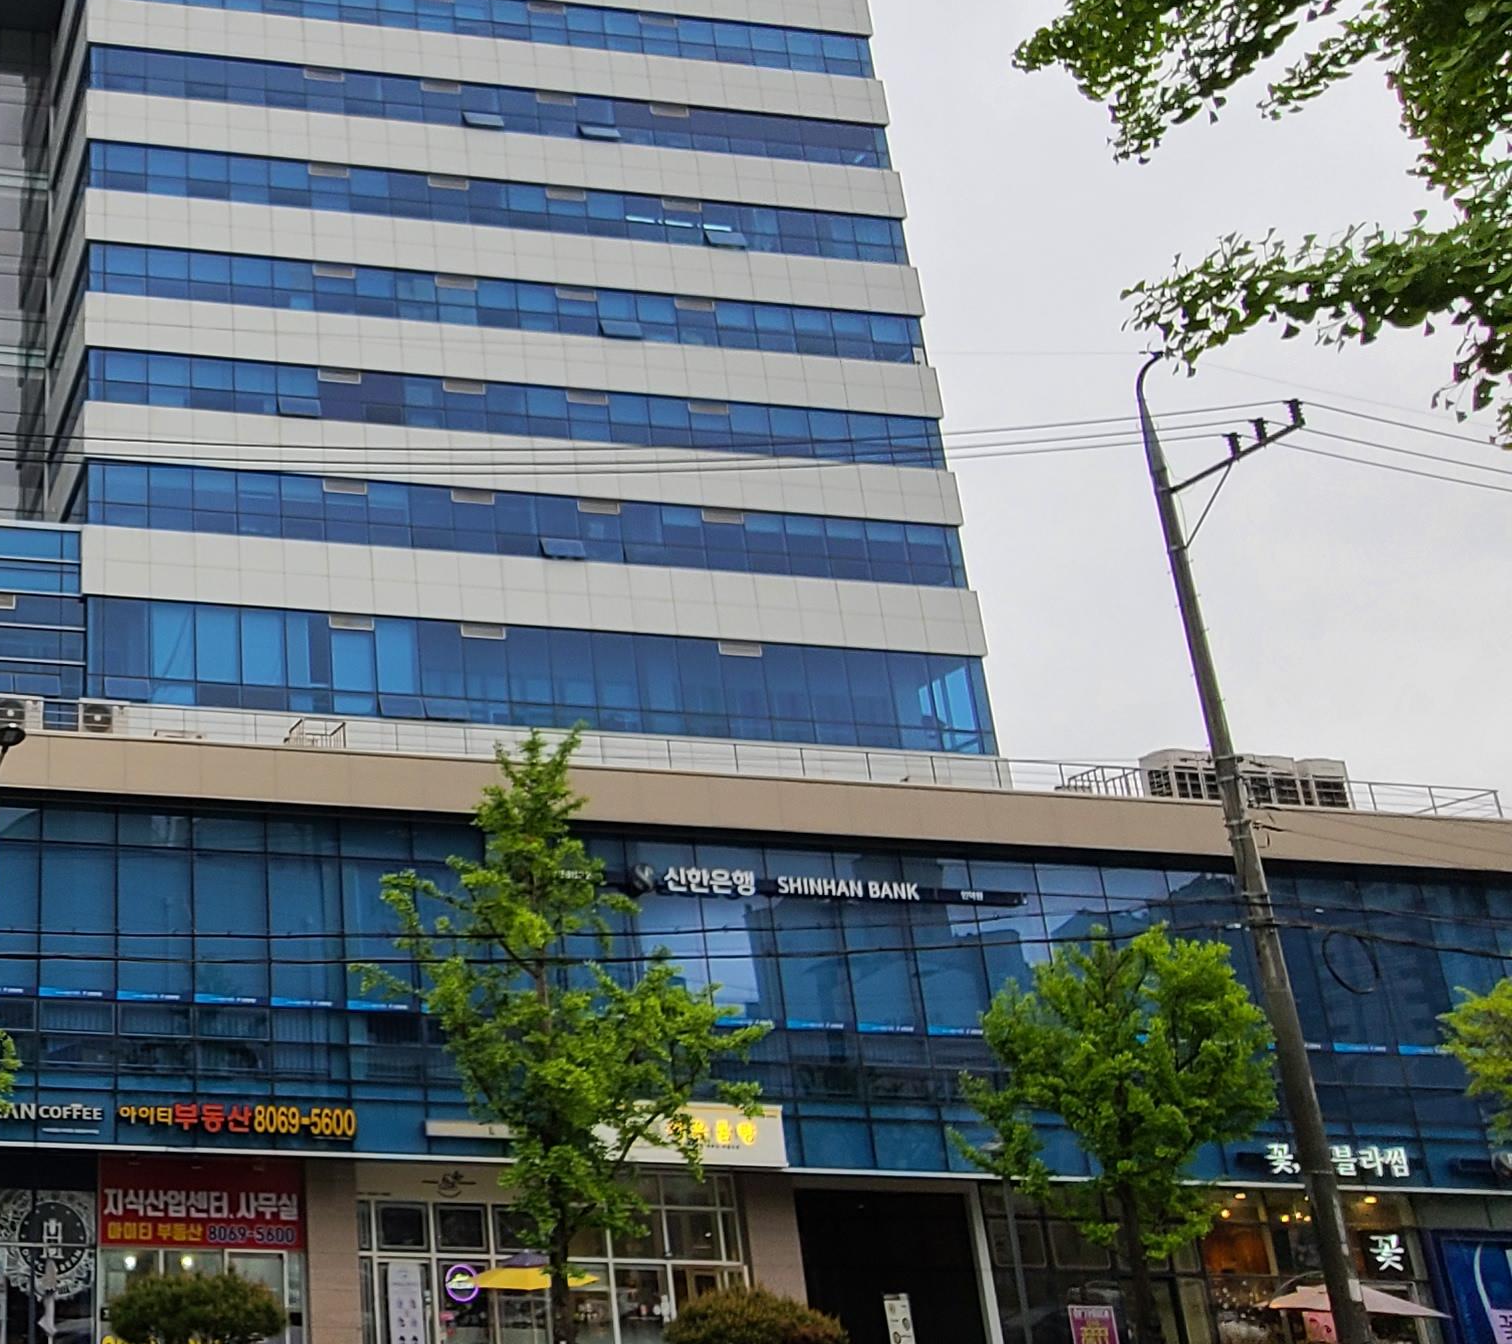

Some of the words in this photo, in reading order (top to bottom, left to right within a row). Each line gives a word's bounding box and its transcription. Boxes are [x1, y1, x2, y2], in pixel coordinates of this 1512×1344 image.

[664, 866, 755, 896] 신한은행
[777, 876, 863, 899] SHINHAN
[868, 882, 920, 901] BANK
[38, 1104, 104, 1121] COFFEE
[119, 1105, 173, 1125] 아이티
[174, 1103, 251, 1133] 부동산
[253, 1106, 356, 1137] 8069-5600
[107, 1222, 153, 1240] 아이티
[157, 1223, 203, 1241] 부동산
[207, 1225, 296, 1243] 8069-5600
[1369, 1234, 1405, 1271] 꽃
